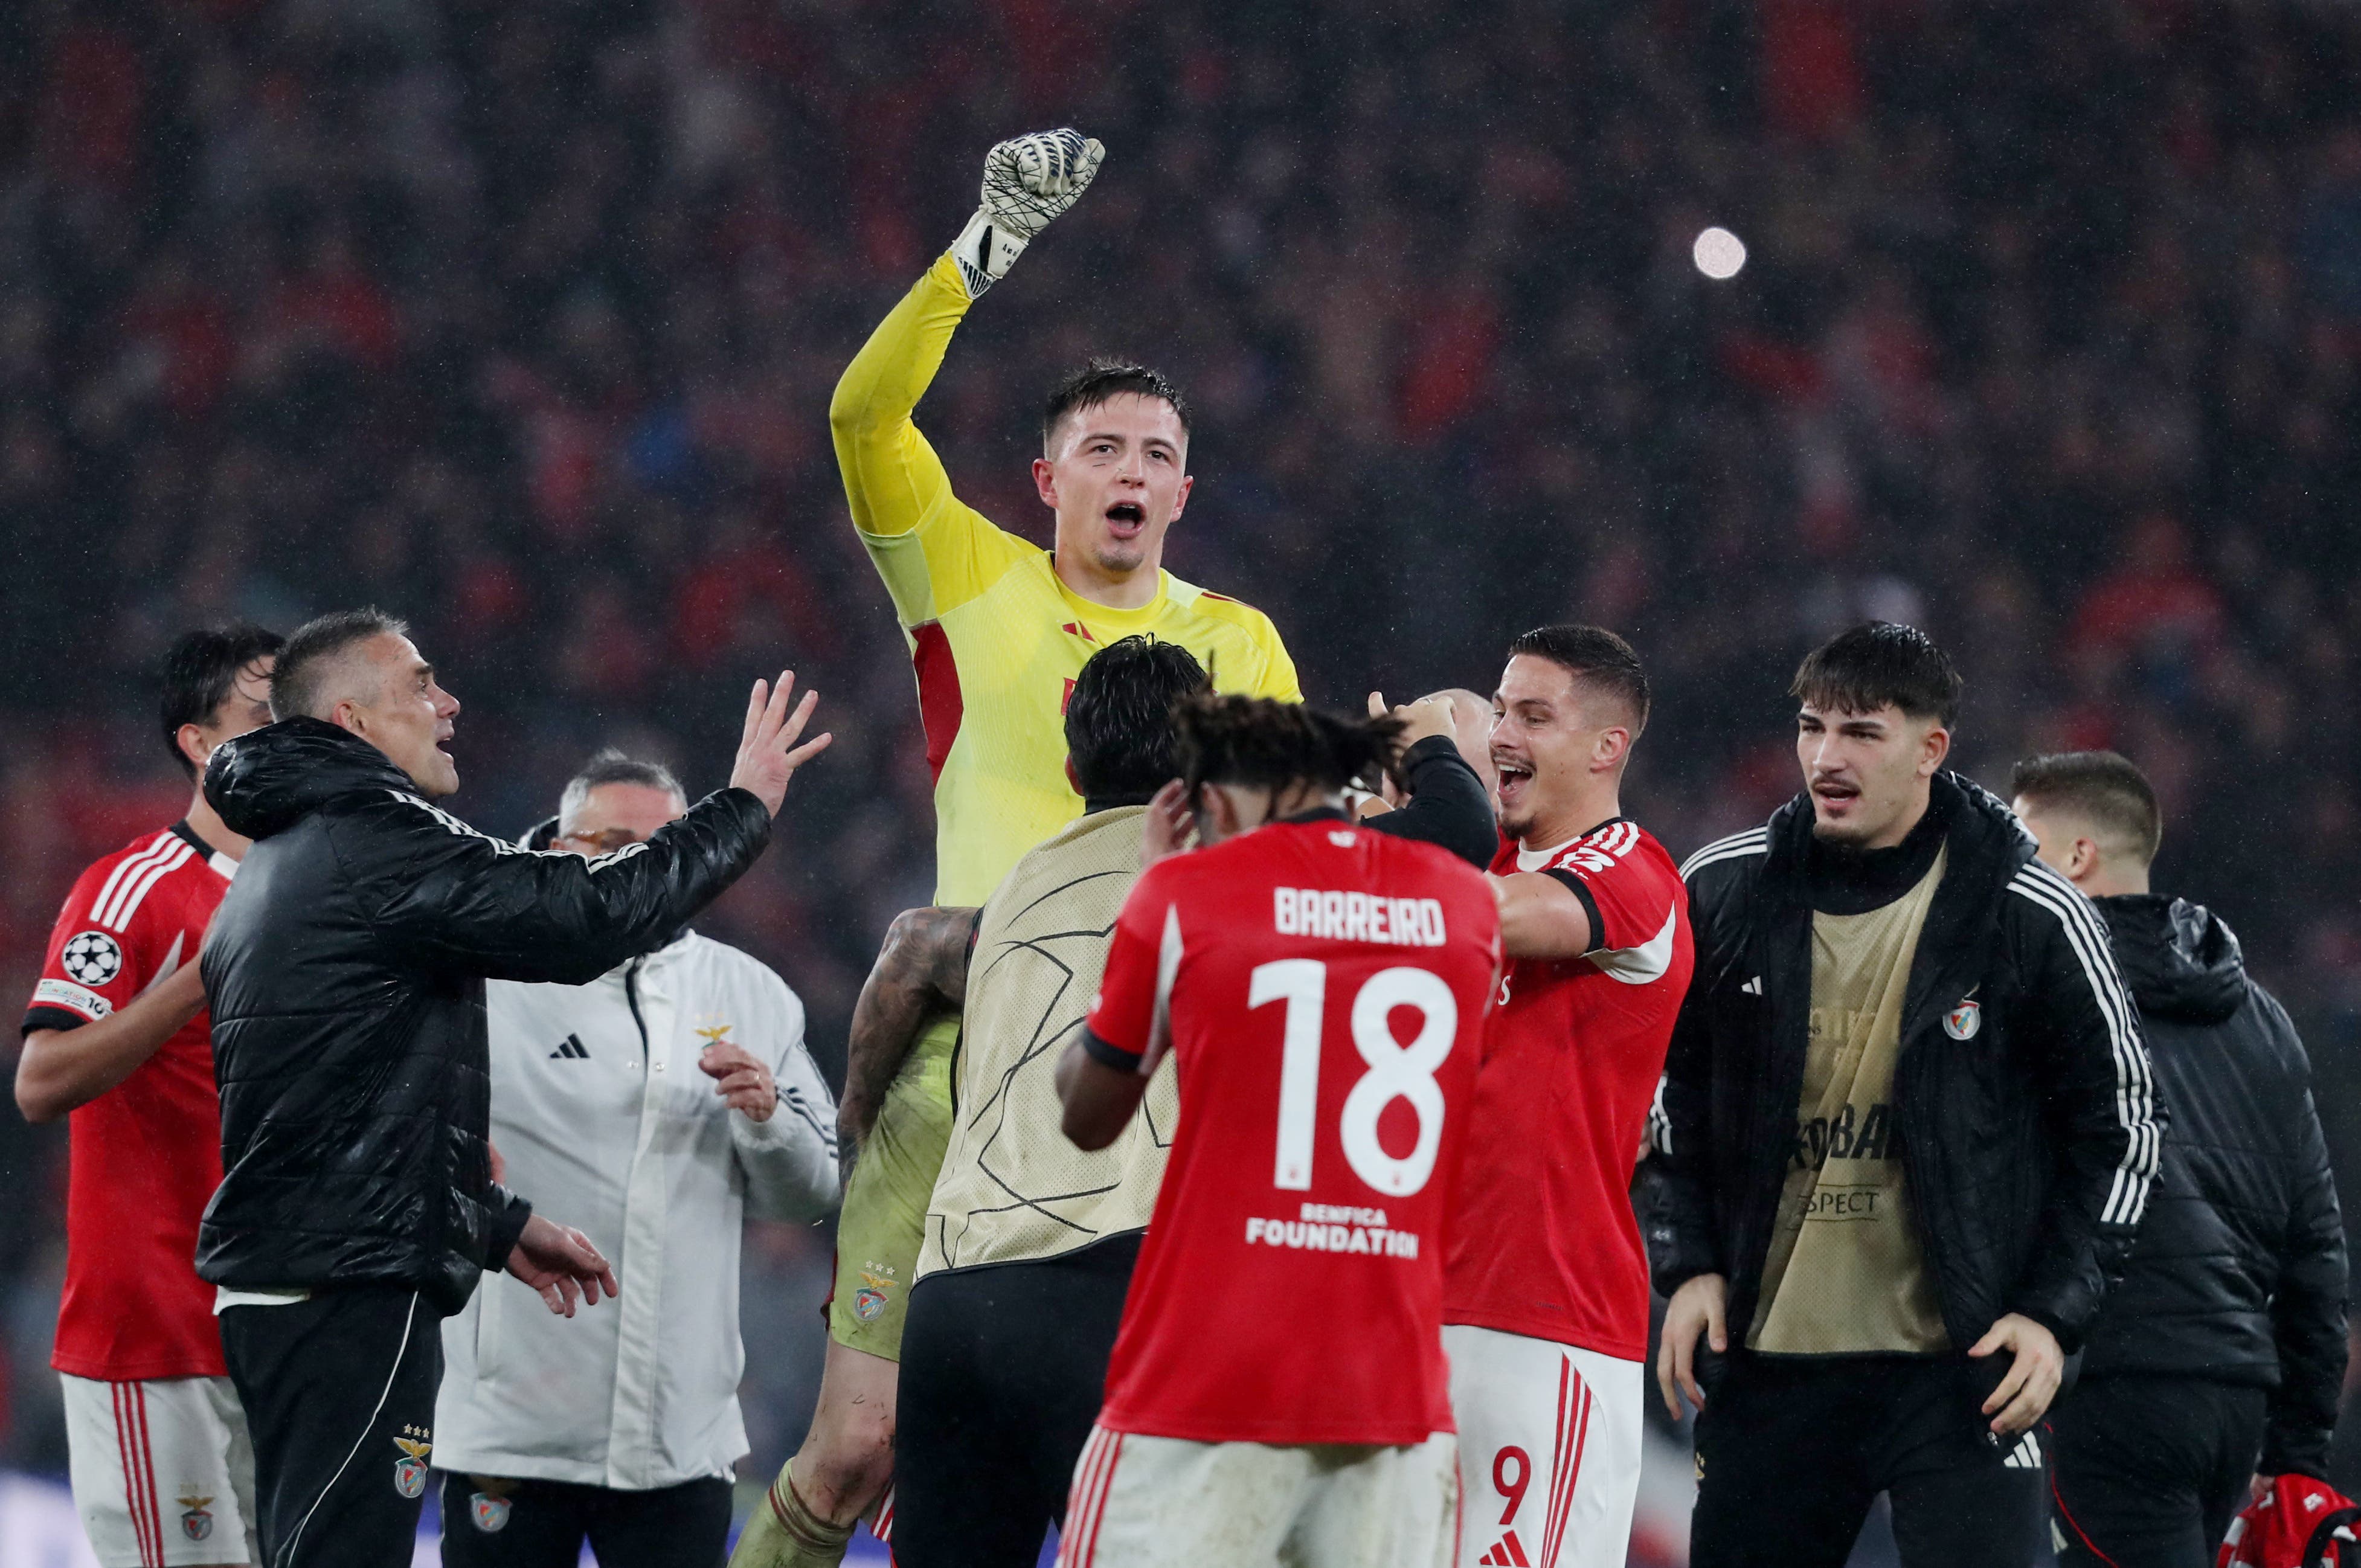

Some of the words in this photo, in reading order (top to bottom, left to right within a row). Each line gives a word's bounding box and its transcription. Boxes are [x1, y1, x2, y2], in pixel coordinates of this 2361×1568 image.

[1273, 886, 1447, 947] BARREIRO
[1247, 957, 1458, 1197] 18
[1300, 1202, 1387, 1227] BENFICA
[1492, 1445, 1531, 1525] 9
